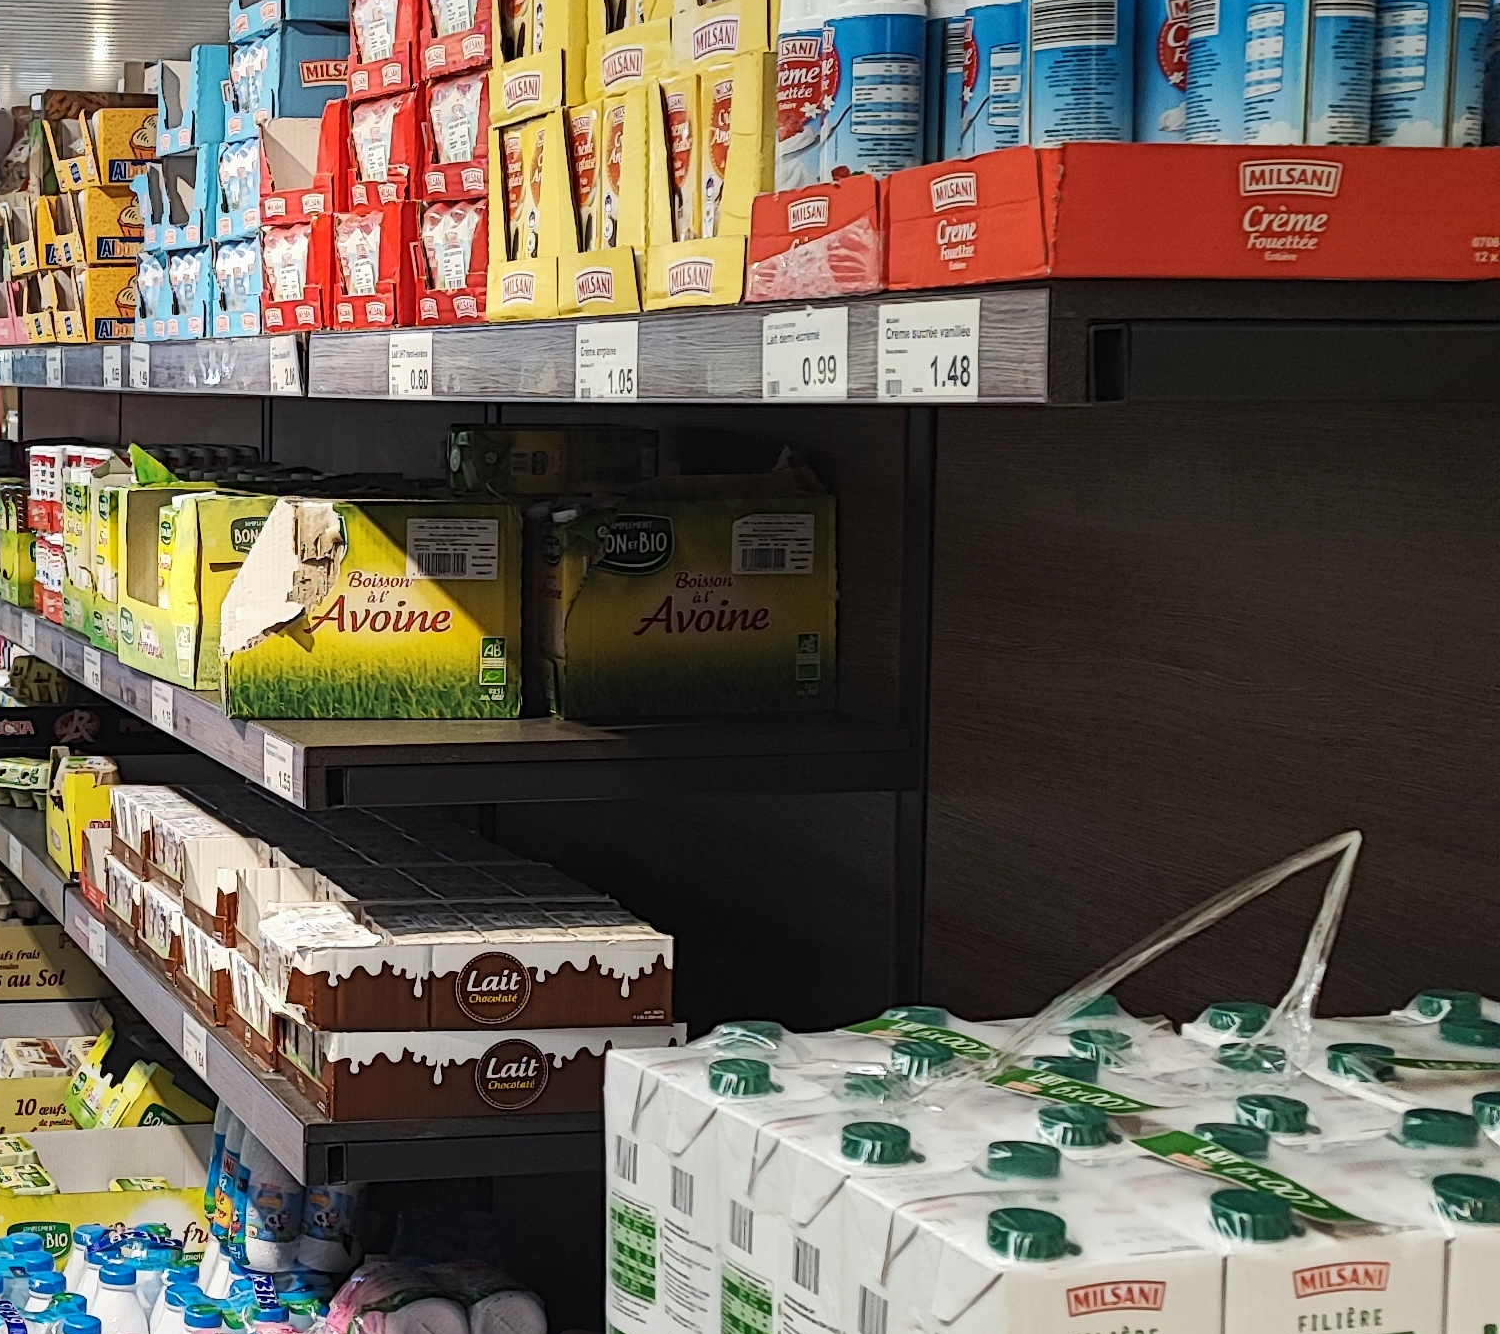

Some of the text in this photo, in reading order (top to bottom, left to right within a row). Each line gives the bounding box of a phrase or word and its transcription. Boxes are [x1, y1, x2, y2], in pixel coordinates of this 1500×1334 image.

[696, 24, 737, 53] MILSANI
[604, 53, 642, 80] MILSANI
[505, 77, 540, 107] MILSANI
[1249, 168, 1332, 187] MILSANI
[935, 180, 974, 203] MILSANI
[792, 204, 826, 223] MILSANI
[1243, 205, 1329, 233] Crème
[938, 218, 977, 245] Crème
[1247, 233, 1318, 250] Fouettée
[504, 277, 534, 301] MILSANI
[578, 273, 614, 299] MILSANI
[670, 264, 712, 292] MILSANI
[608, 369, 633, 394] 1.05
[802, 355, 837, 385] 0.99
[931, 355, 971, 387] 1.48
[640, 533, 668, 553] BIO
[348, 571, 413, 589] Boisson
[675, 572, 734, 589] Boisson
[368, 591, 378, 603] à
[304, 595, 451, 634] Avoine
[633, 597, 771, 635] Avoine
[16, 949, 41, 962] frais
[8, 974, 31, 988] au
[36, 970, 65, 987] Sol
[467, 969, 522, 992] Lait
[486, 1056, 540, 1079] Lait
[15, 1099, 37, 1116] 10
[1195, 1145, 1242, 1165] LAIT
[47, 1234, 68, 1250] BIO
[1301, 1268, 1384, 1292] MILSANI
[1074, 1287, 1160, 1309] MILSANI
[1298, 1307, 1383, 1332] FILIÈRE
